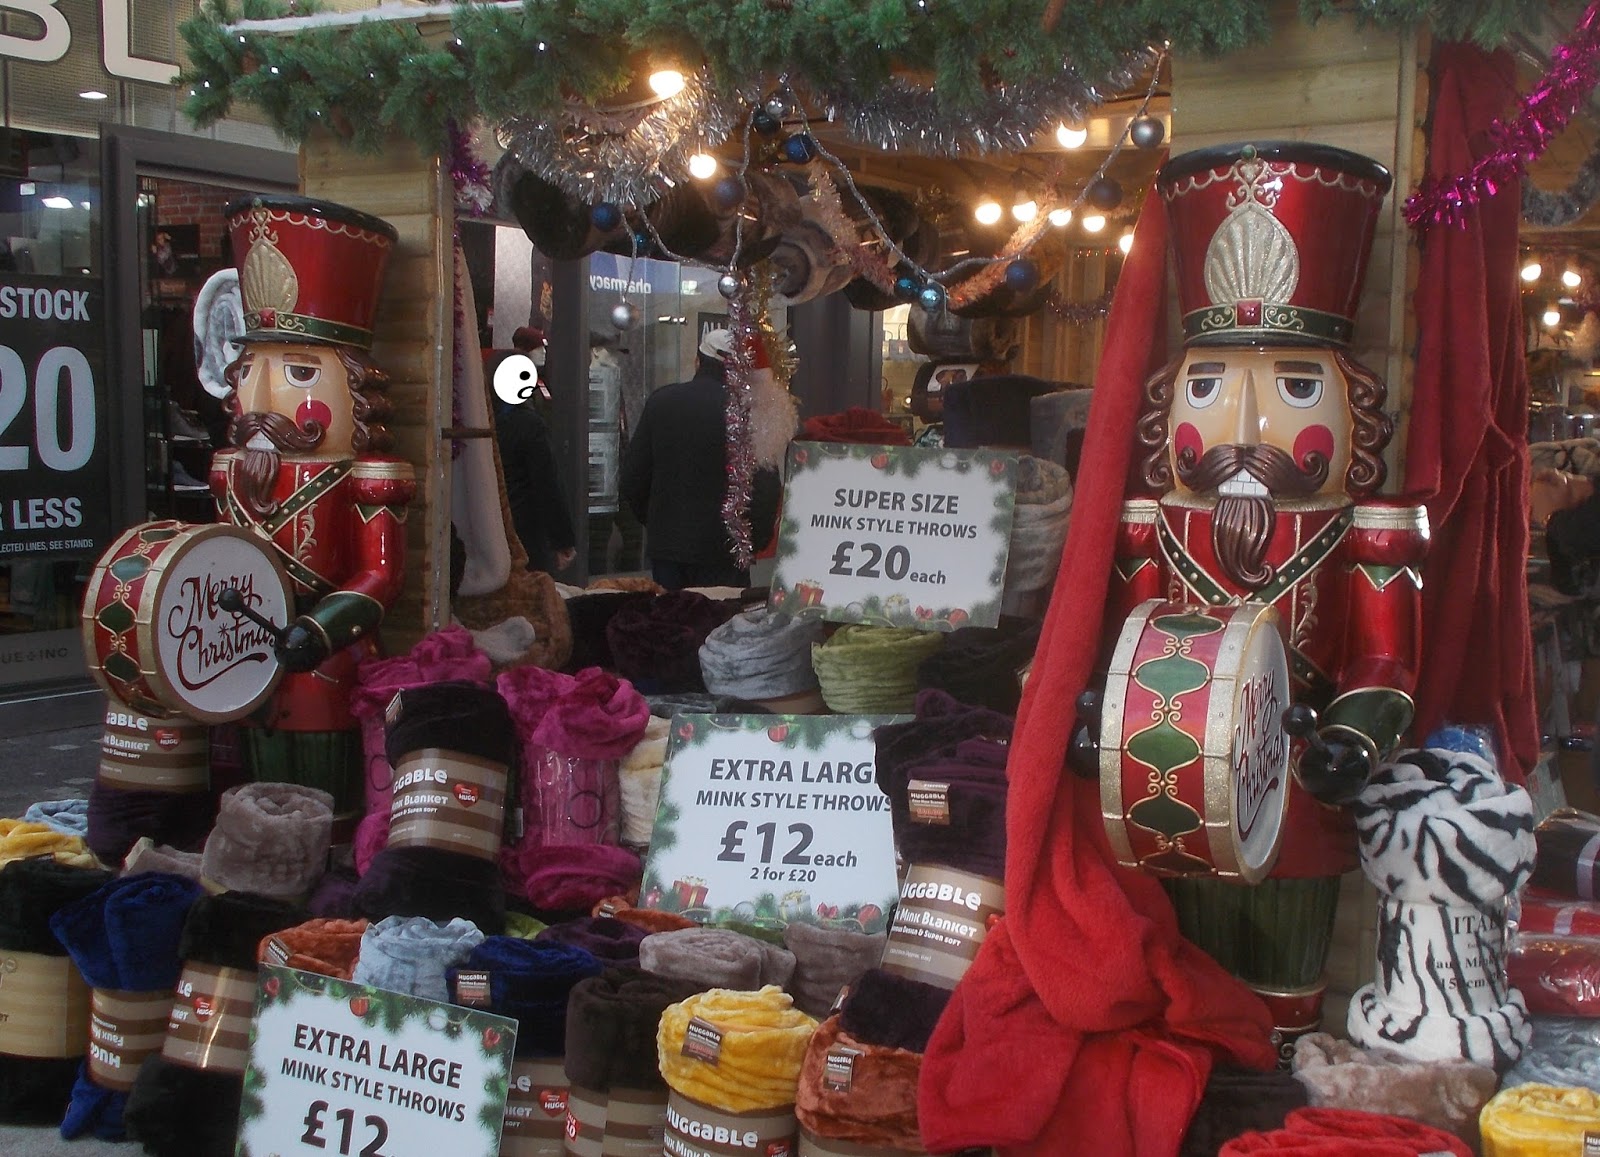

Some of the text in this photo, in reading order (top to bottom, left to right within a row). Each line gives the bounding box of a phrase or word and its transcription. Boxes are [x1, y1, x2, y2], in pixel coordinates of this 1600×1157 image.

[13, 497, 83, 530] LESS
[833, 488, 959, 515] SUPER SIZE
[810, 513, 977, 539] MINK STYLE THROWS
[49, 541, 63, 550] SEE
[65, 539, 94, 549] STANDS
[829, 540, 946, 585] £20 each
[168, 573, 262, 639] Merry
[710, 758, 879, 785] EXTRA LARG
[696, 789, 748, 807] MINK
[750, 791, 808, 810] STYLE
[812, 793, 891, 812] THROWS
[717, 820, 815, 866] £12
[813, 850, 858, 868] each
[749, 866, 817, 882] 2 for £20
[293, 1023, 463, 1089] EXTRA LARGE
[280, 1057, 466, 1122] MINK STYLE THROWS
[301, 1099, 396, 1157] £12
